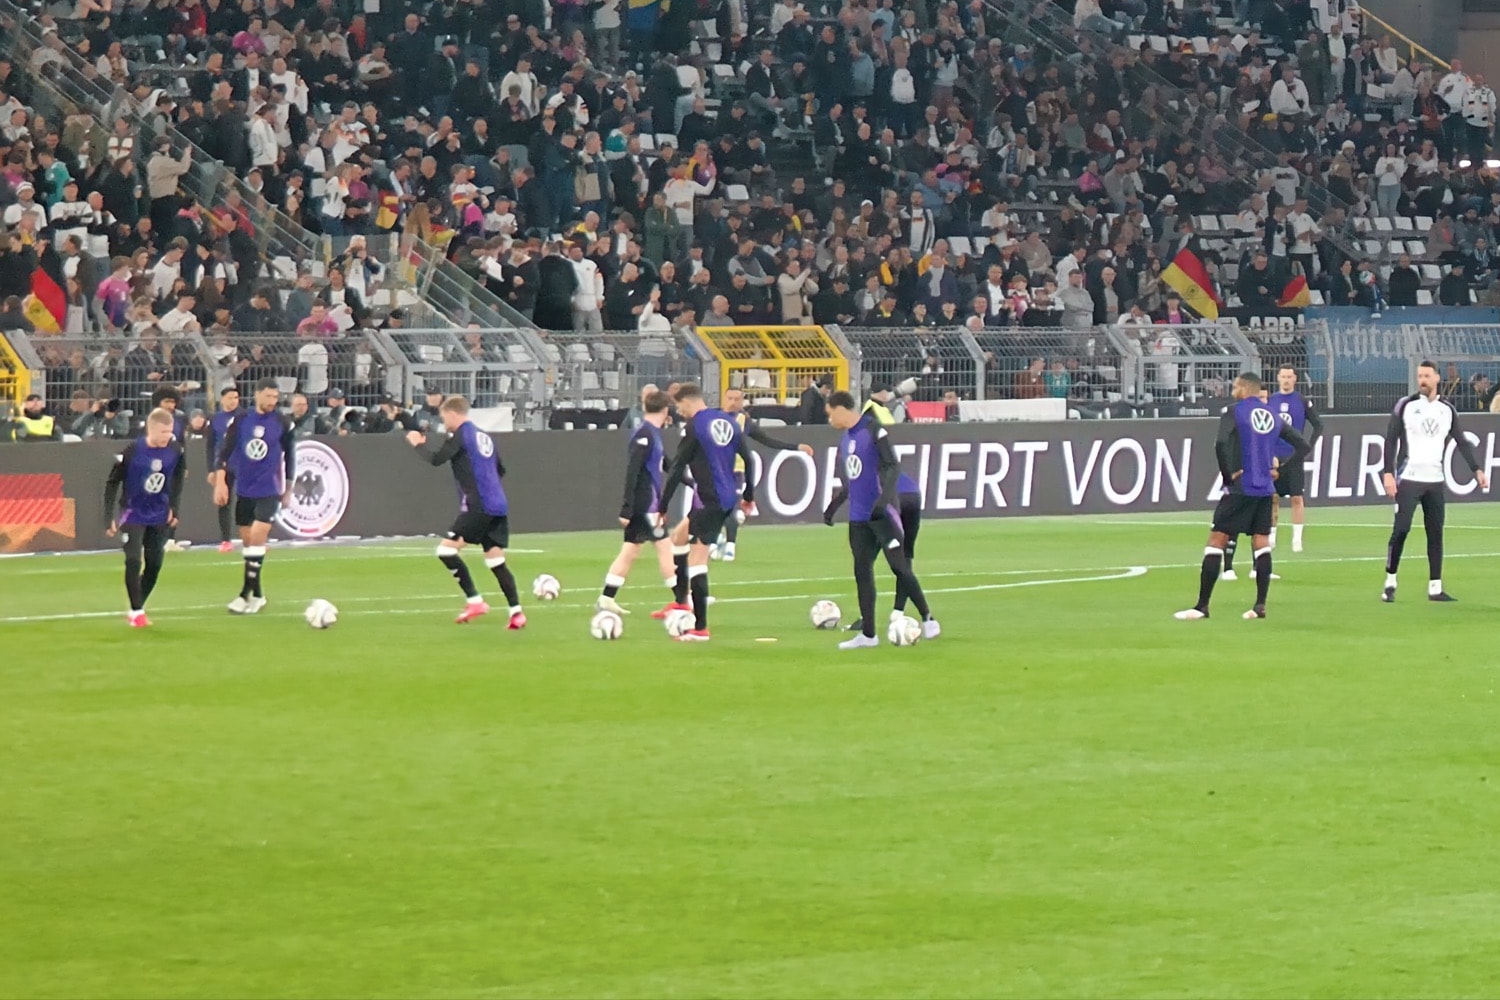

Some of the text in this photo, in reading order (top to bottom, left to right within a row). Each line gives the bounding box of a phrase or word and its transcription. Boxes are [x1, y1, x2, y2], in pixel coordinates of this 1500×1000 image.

[710, 418, 734, 446] VW
[1251, 408, 1275, 434] VW
[1062, 438, 1192, 505] VON
